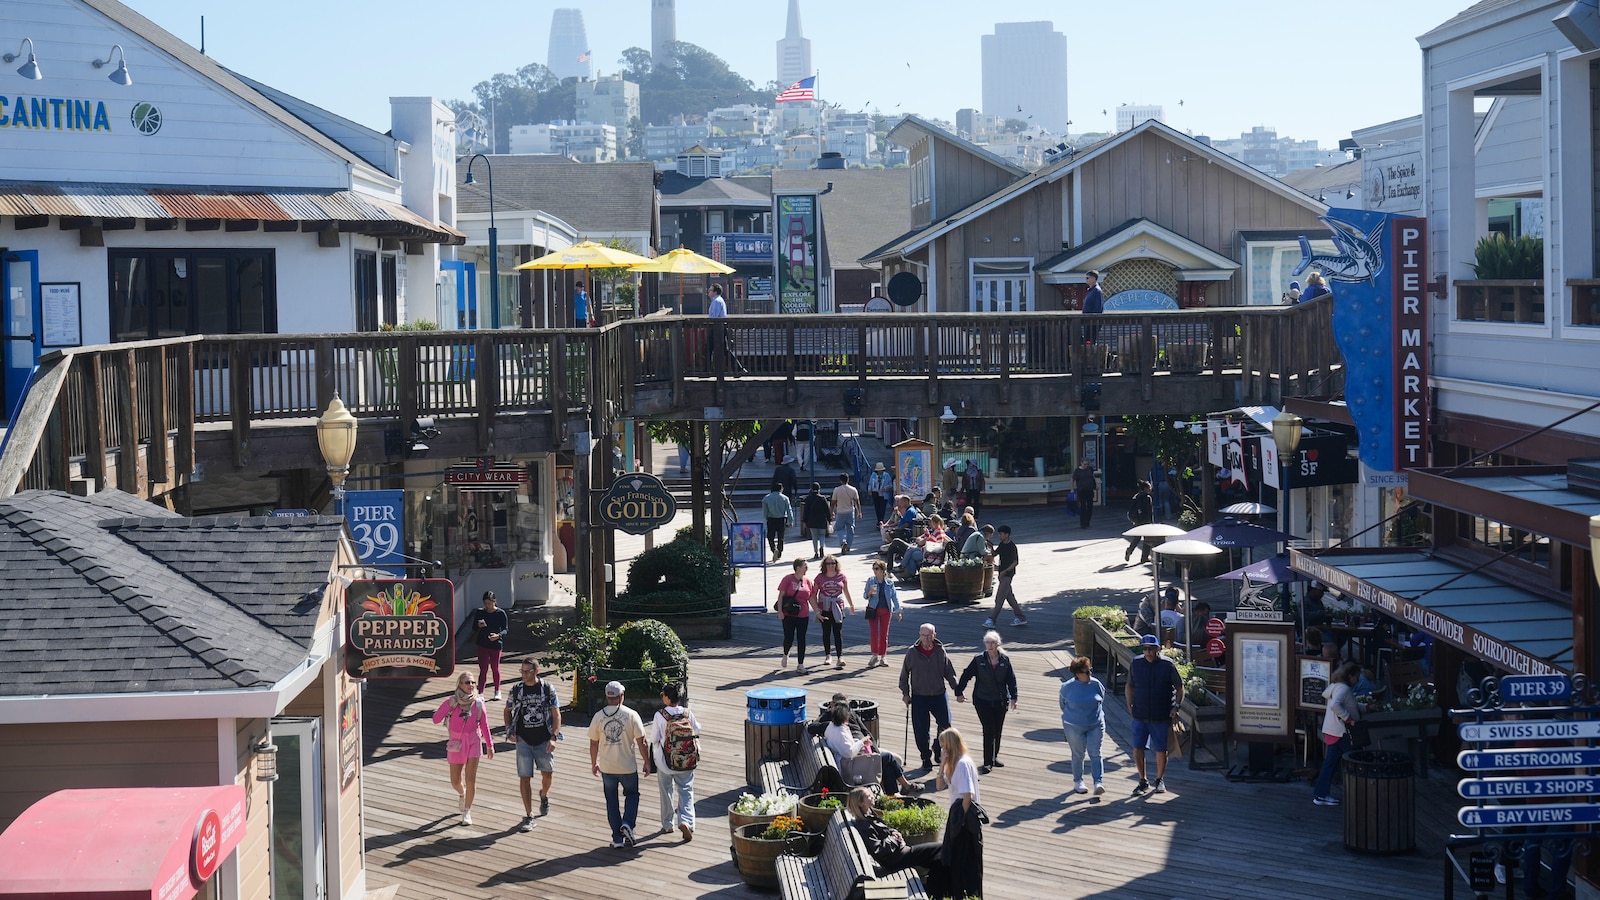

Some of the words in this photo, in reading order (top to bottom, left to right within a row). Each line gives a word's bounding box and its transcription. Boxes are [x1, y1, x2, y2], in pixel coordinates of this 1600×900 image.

[0, 95, 111, 131] CANTINA
[1387, 167, 1396, 180] The
[1397, 165, 1410, 182] Spice
[1411, 163, 1416, 176] &
[1388, 185, 1396, 199] Tea
[1397, 183, 1420, 199] Exchange
[1402, 228, 1420, 315] PIER
[1401, 329, 1421, 462] MARKET
[1300, 450, 1308, 463] I
[485, 472, 512, 480] WEAR
[1301, 461, 1319, 476] SF
[1370, 475, 1394, 483] SINCE
[611, 496, 625, 504] San
[627, 492, 663, 503] Francisco
[352, 505, 396, 521] PIER
[607, 502, 668, 519] GOLD
[353, 523, 399, 559] 39
[1295, 554, 1330, 582] WATERFRONT
[1330, 570, 1351, 591] DINING
[1357, 581, 1371, 600] FISH
[1371, 588, 1377, 603] &
[1377, 591, 1397, 614] CHIPS
[358, 620, 440, 636] PEPPER
[1403, 602, 1424, 626] CLAM
[1424, 612, 1464, 644] CHOWDER
[364, 638, 434, 649] PARADISE
[1472, 633, 1530, 675] SOURDOUGH
[364, 660, 381, 669] HOT
[413, 658, 434, 668] MORE
[1510, 682, 1547, 696] PIER
[1548, 681, 1565, 695] 39
[1489, 725, 1533, 739] SWISS
[1537, 724, 1579, 737] LOUIS
[1494, 752, 1582, 767] RESTROOMS
[1487, 782, 1530, 795] LEVEL
[1534, 782, 1542, 793] 2
[1546, 780, 1594, 793] SHOPS
[1496, 810, 1524, 823] BAY
[1527, 808, 1573, 822] VIEWS
